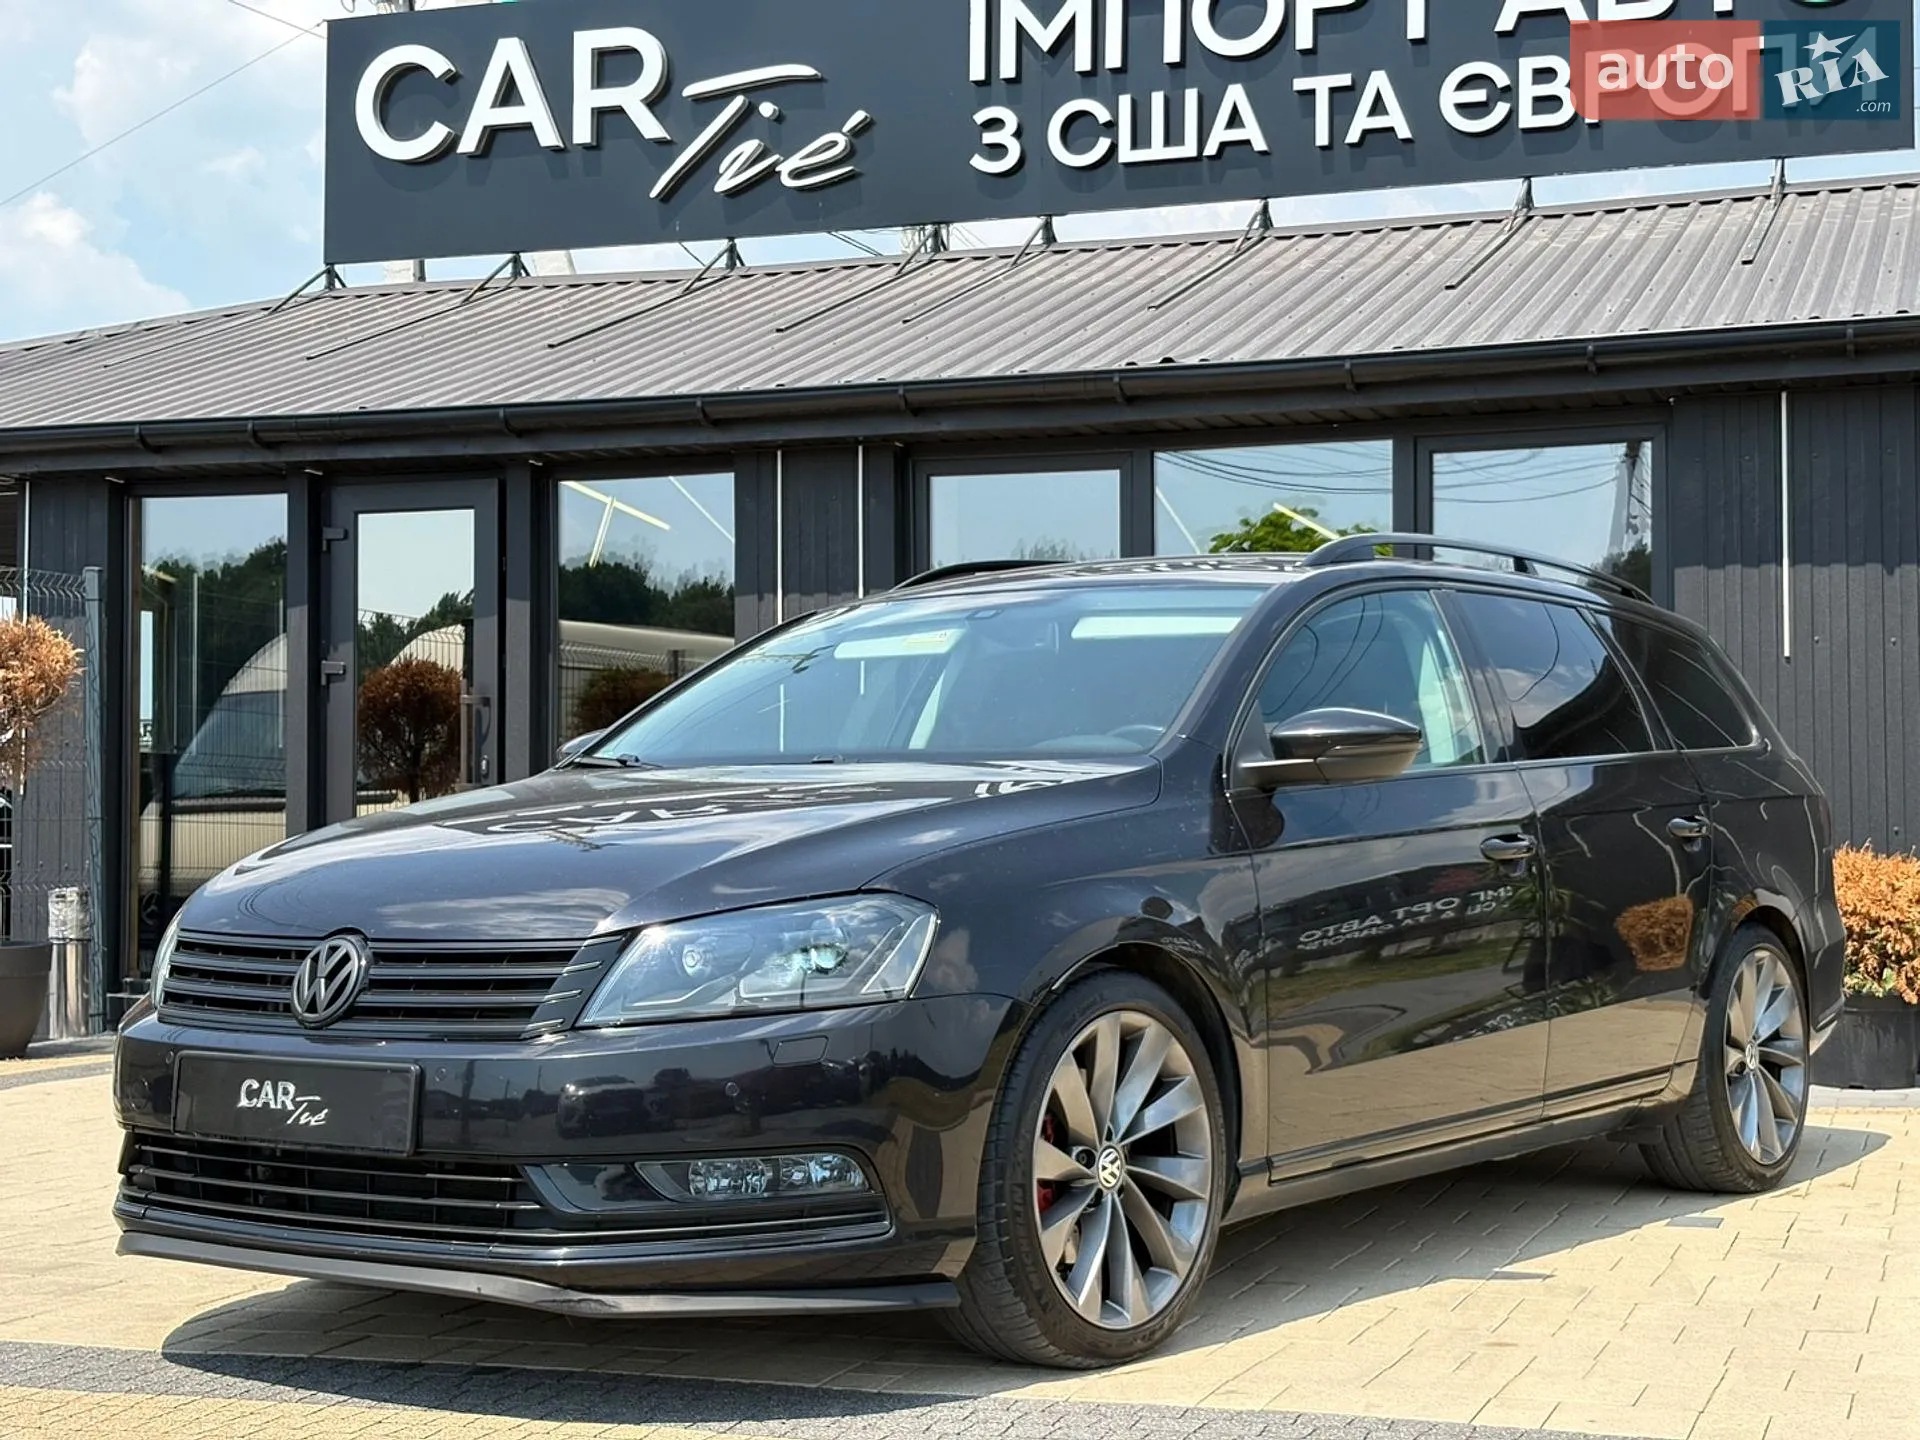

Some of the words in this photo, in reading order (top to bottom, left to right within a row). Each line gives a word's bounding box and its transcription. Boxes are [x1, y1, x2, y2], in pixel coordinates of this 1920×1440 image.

[354, 26, 674, 163] CAR
[968, 105, 1024, 176] З
[1046, 82, 1271, 168] США
[1292, 69, 1415, 149] ТА
[237, 1078, 296, 1110] CAR
